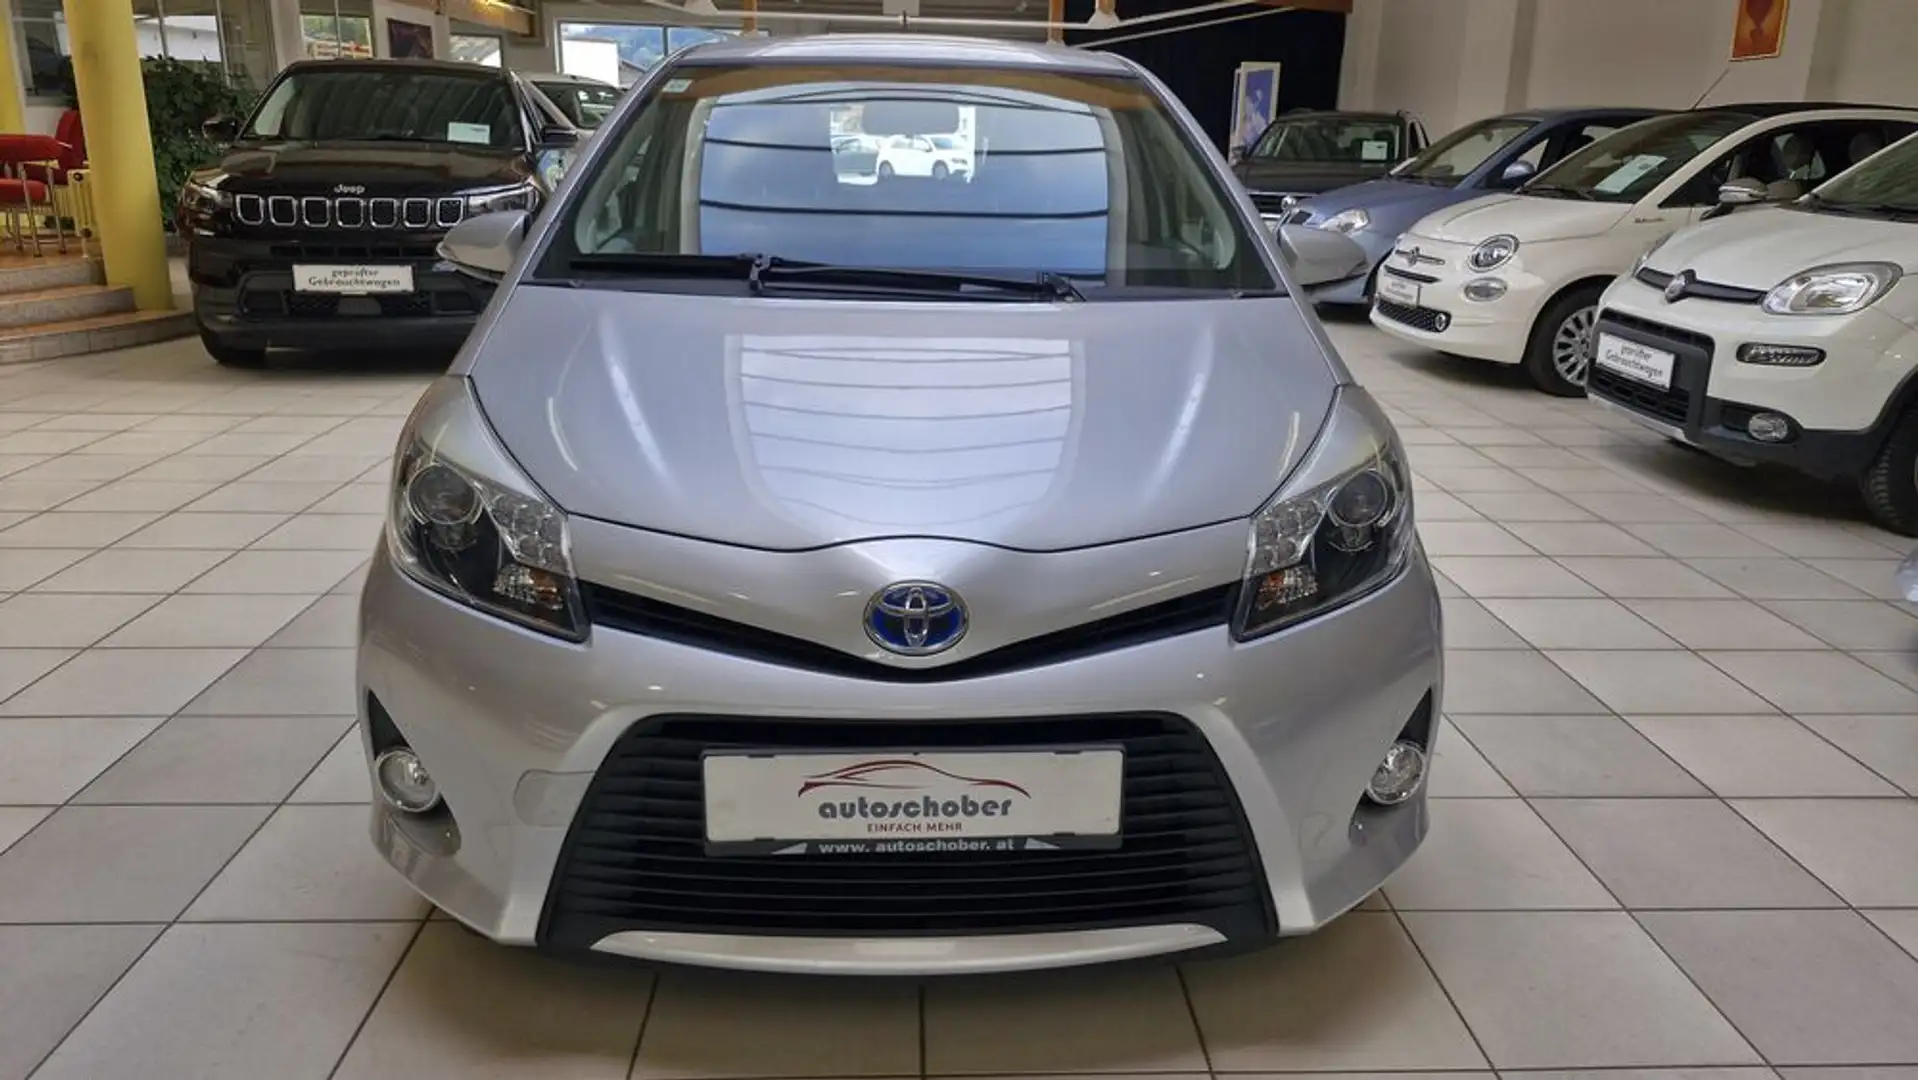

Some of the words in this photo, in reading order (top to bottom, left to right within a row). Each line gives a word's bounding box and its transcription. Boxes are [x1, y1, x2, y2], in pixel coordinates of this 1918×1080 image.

[334, 183, 366, 195] Jeep
[818, 795, 1012, 819] autoschober
[867, 823, 921, 833] EINFACH
[926, 822, 962, 832] MEHR
